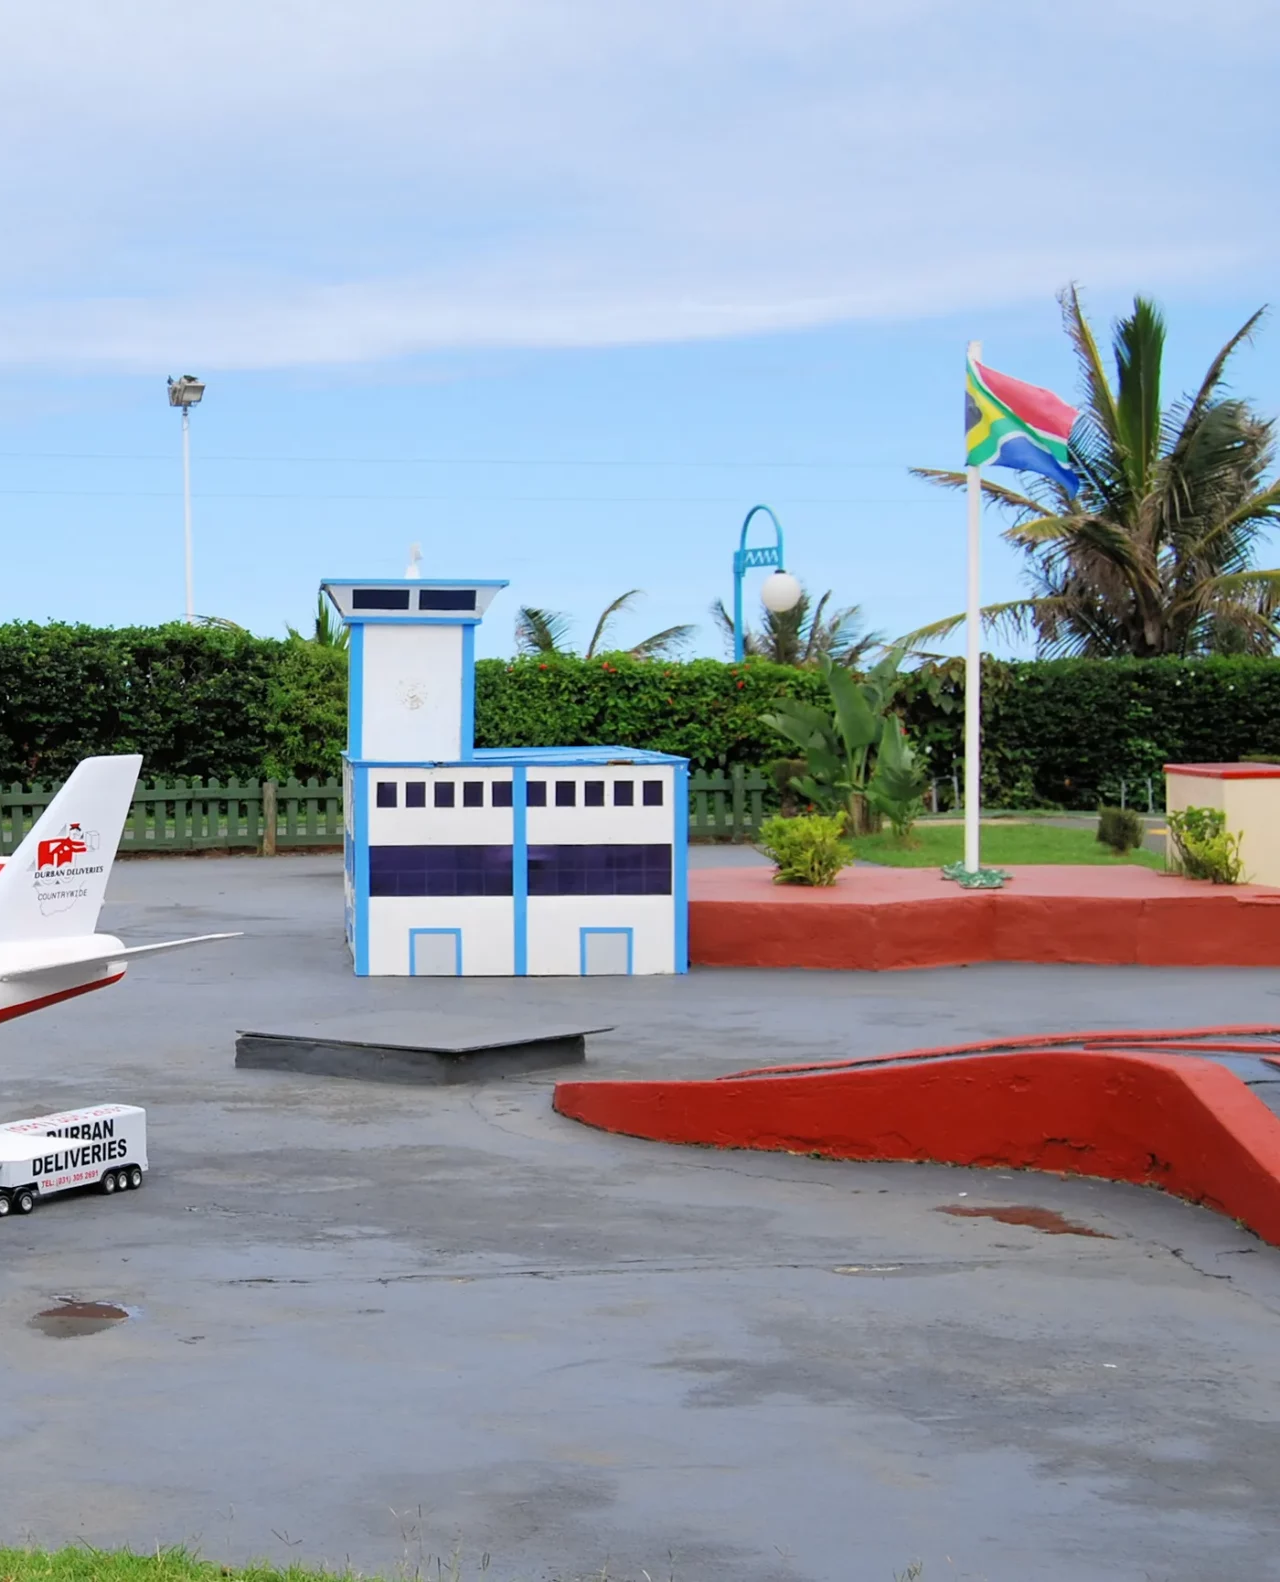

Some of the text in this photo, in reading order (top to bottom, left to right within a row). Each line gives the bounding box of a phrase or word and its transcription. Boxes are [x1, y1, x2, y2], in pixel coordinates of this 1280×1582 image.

[34, 866, 104, 879] DURBAN DELIVERIES
[37, 889, 88, 901] COUNTRYWIDE
[32, 1138, 128, 1177] DELIVERIES
